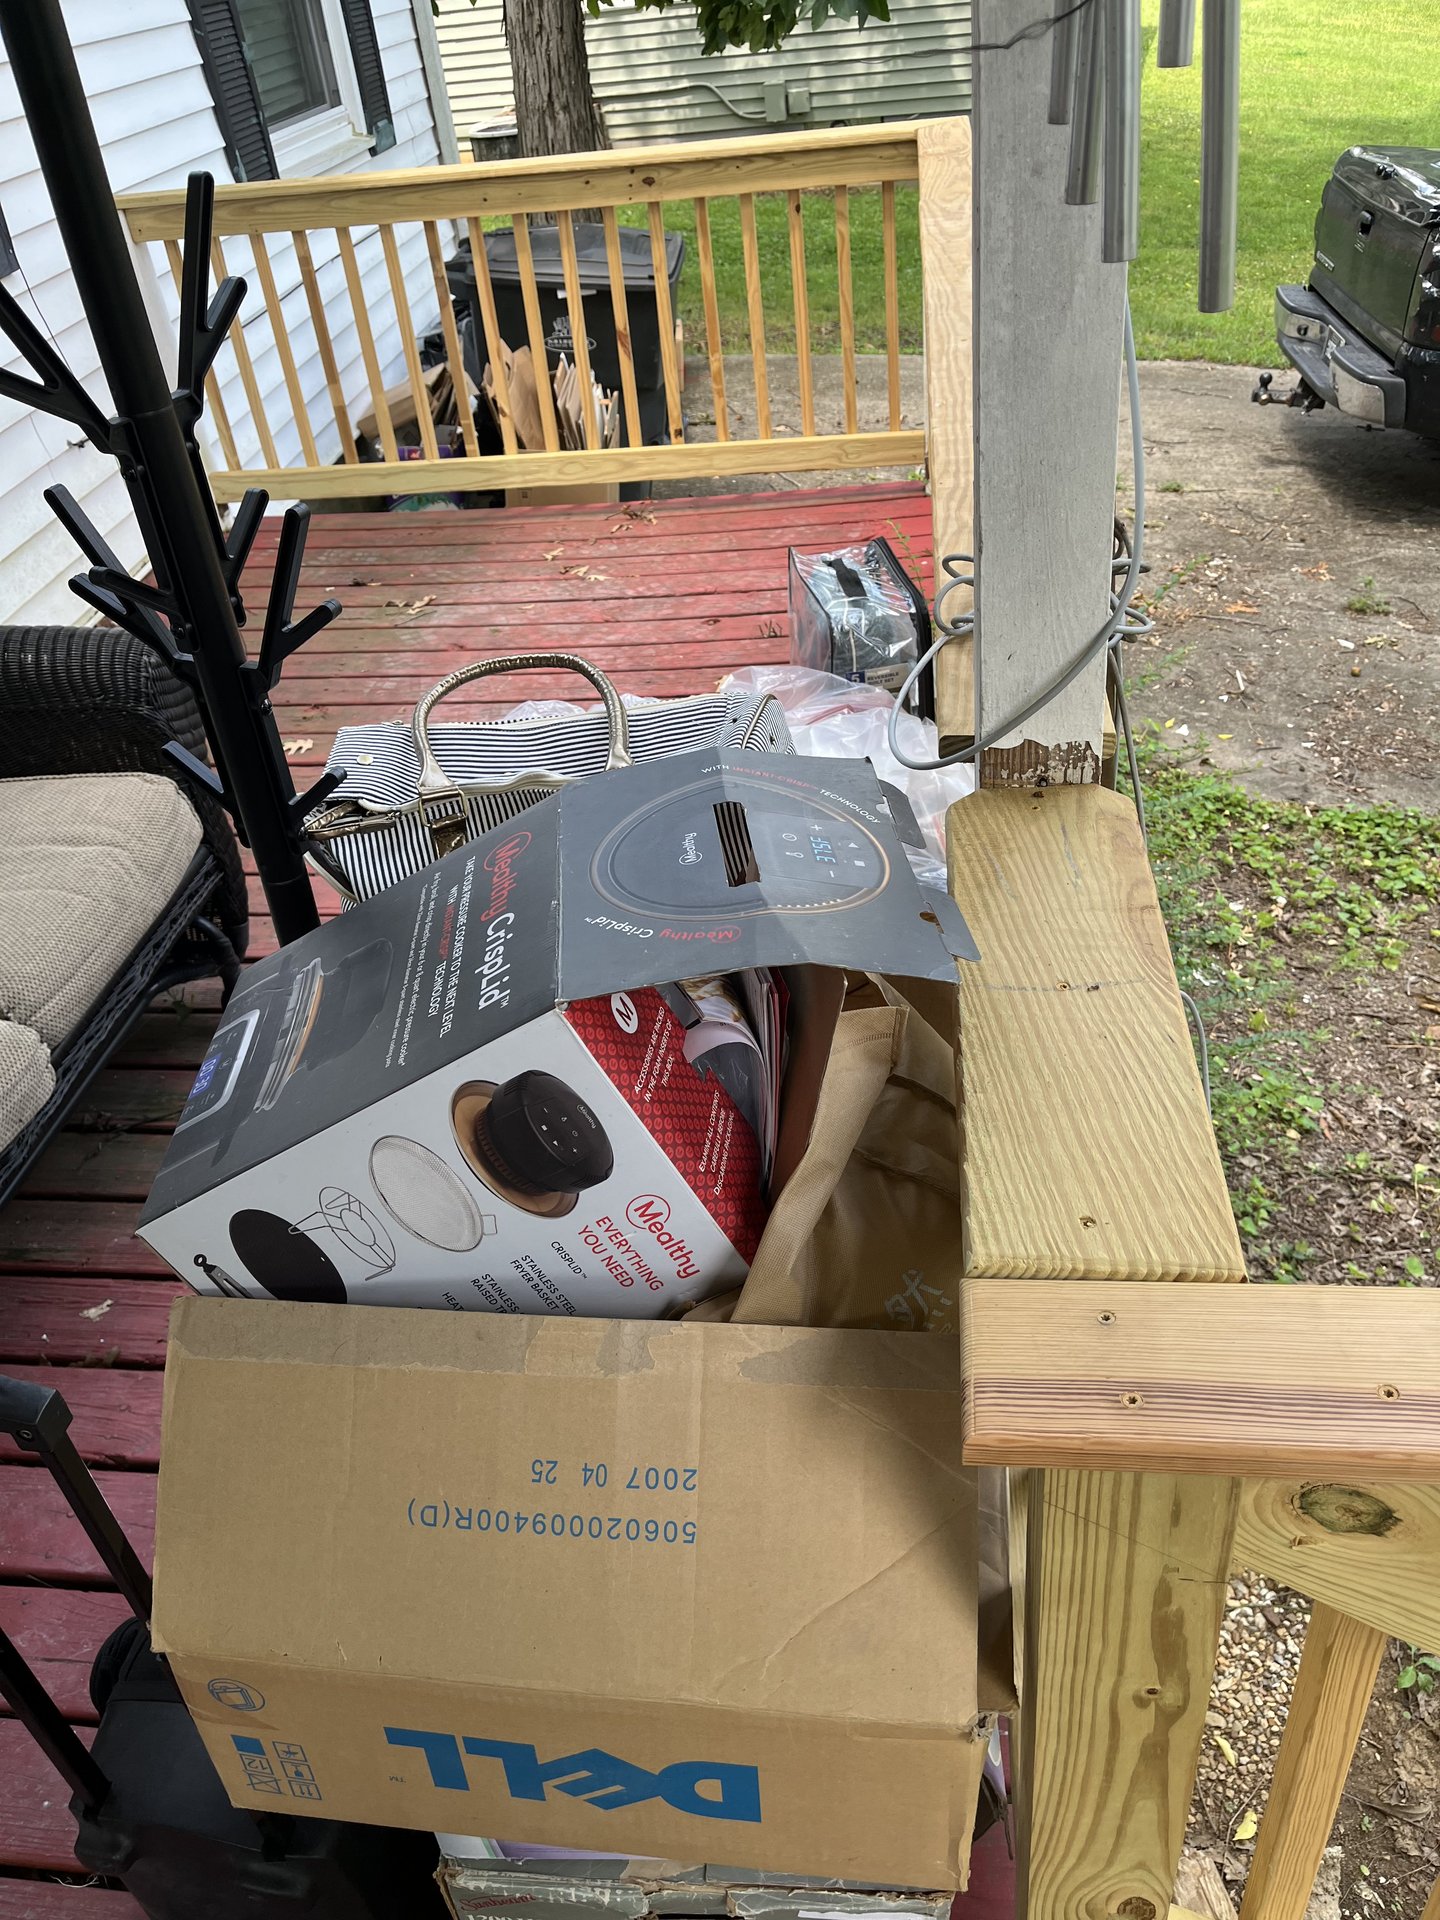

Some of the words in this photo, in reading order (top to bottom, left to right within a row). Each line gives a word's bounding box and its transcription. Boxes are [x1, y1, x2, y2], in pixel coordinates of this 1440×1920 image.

[867, 672, 899, 681] REVERSIBLE
[701, 764, 730, 774] WITH
[819, 789, 881, 823] TECHNOLOGY
[682, 832, 700, 864] Mealthy
[464, 856, 475, 875] TAKE
[481, 835, 526, 922] Mealthy
[447, 885, 458, 905] WITH
[461, 873, 473, 894] YOUR
[456, 891, 470, 928] PRESSURE
[451, 925, 465, 960] COOKER
[659, 927, 737, 942] Mealthy
[447, 970, 459, 988] THE
[450, 957, 461, 972] TO
[412, 977, 420, 993] quart
[427, 961, 446, 1017] TECHNOLOGY
[443, 987, 457, 1010] NEXT
[407, 992, 420, 1016] electric
[614, 996, 635, 1028] M
[402, 1016, 413, 1043] pressure
[439, 1009, 453, 1038] LEVEL
[634, 1041, 653, 1094] ACCESSORIES
[654, 1005, 664, 1033] PACKED
[644, 1089, 651, 1103] IN
[648, 1075, 656, 1091] THE
[653, 1055, 661, 1078] FOAM
[658, 1028, 669, 1058] INSERTS
[666, 1017, 672, 1031] OF
[661, 1068, 669, 1087] THIS
[699, 1136, 710, 1173] EXAMINE
[709, 1088, 719, 1127] CONTENTS
[710, 1132, 721, 1173] CAREFULLY
[717, 1106, 726, 1135] BEFORE
[713, 1149, 727, 1196] DISCARDING
[595, 1215, 664, 1292] EVERYTHING
[630, 1197, 700, 1280] Mealthy
[577, 1225, 604, 1255] YOU
[601, 1254, 635, 1288] NEED
[470, 1278, 498, 1306] RAISED
[482, 1273, 520, 1314] STAINLESS
[510, 1259, 535, 1286] FRYER
[531, 1282, 559, 1311] BASKET
[521, 1255, 558, 1294] STAINLESS
[555, 1293, 577, 1316] STEEL
[531, 1459, 558, 1484] 25
[581, 1463, 608, 1488] 04
[625, 1467, 698, 1491] 2007
[406, 1498, 697, 1544] 506020009400R(D)
